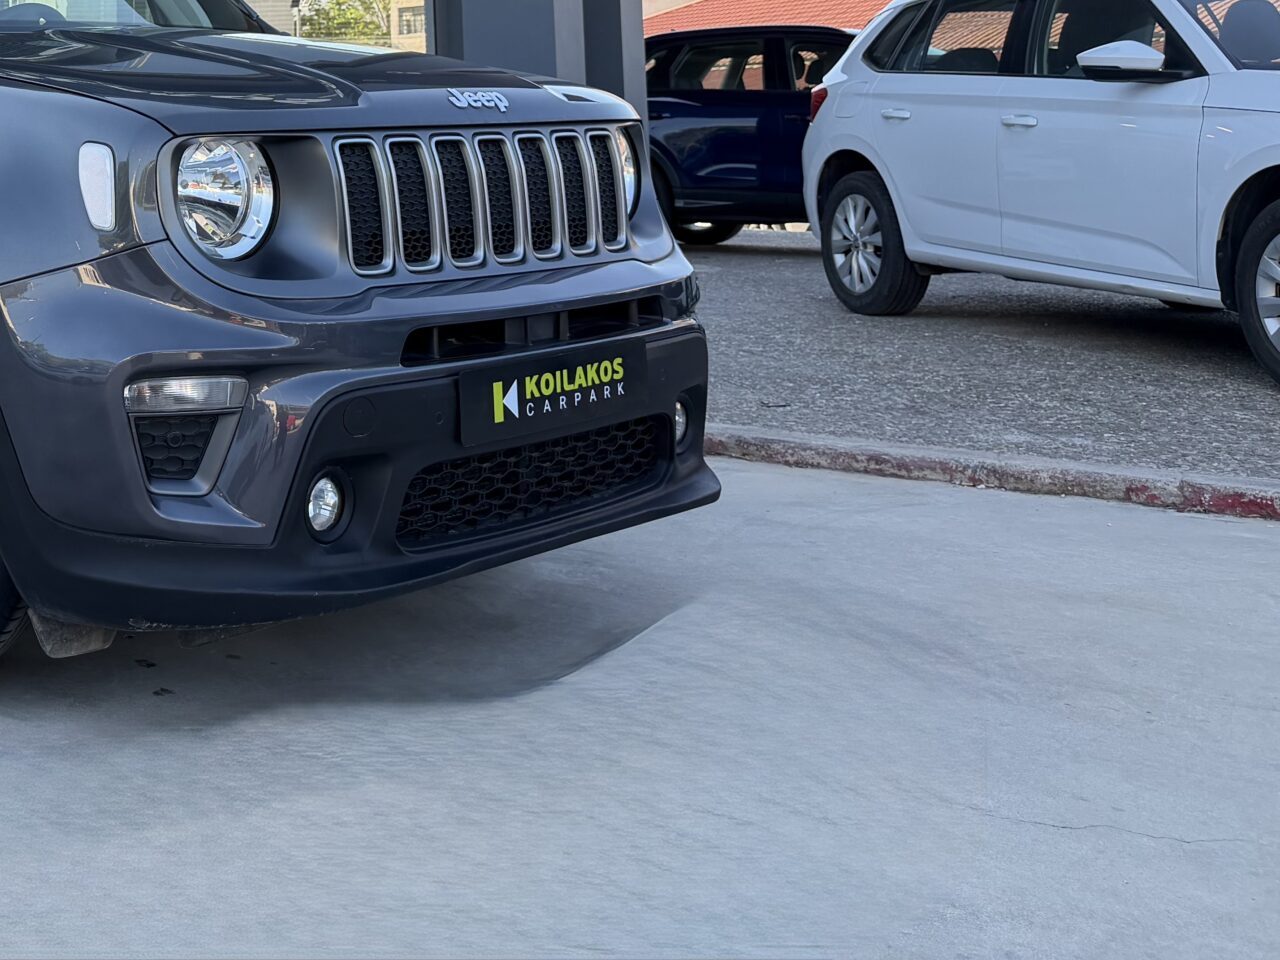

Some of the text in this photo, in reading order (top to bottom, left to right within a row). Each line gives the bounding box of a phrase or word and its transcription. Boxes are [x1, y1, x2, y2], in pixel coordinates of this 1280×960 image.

[447, 87, 510, 113] Jeep
[525, 357, 625, 400] KOILAKOS
[526, 382, 625, 417] CARPARK
